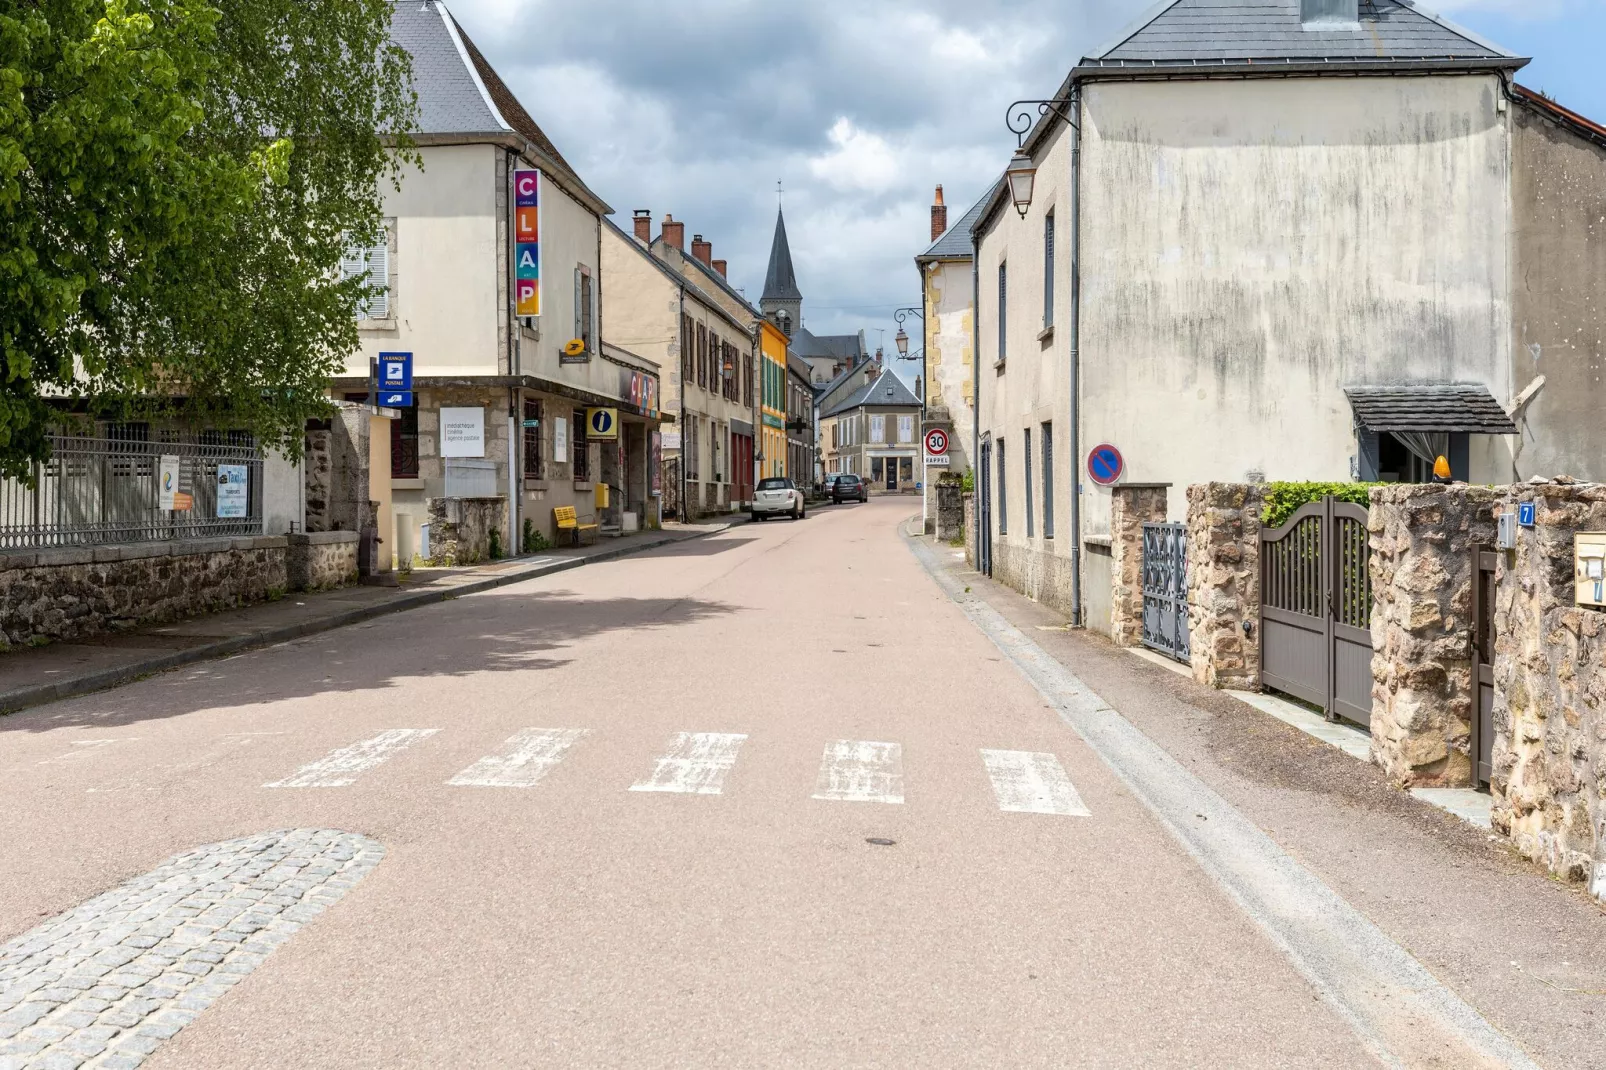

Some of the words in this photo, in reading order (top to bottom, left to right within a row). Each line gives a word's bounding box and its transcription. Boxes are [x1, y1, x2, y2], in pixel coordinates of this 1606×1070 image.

[631, 375, 653, 400] CLAP
[930, 436, 944, 448] 30
[1523, 507, 1529, 523] 7
[1595, 582, 1601, 600] 7
